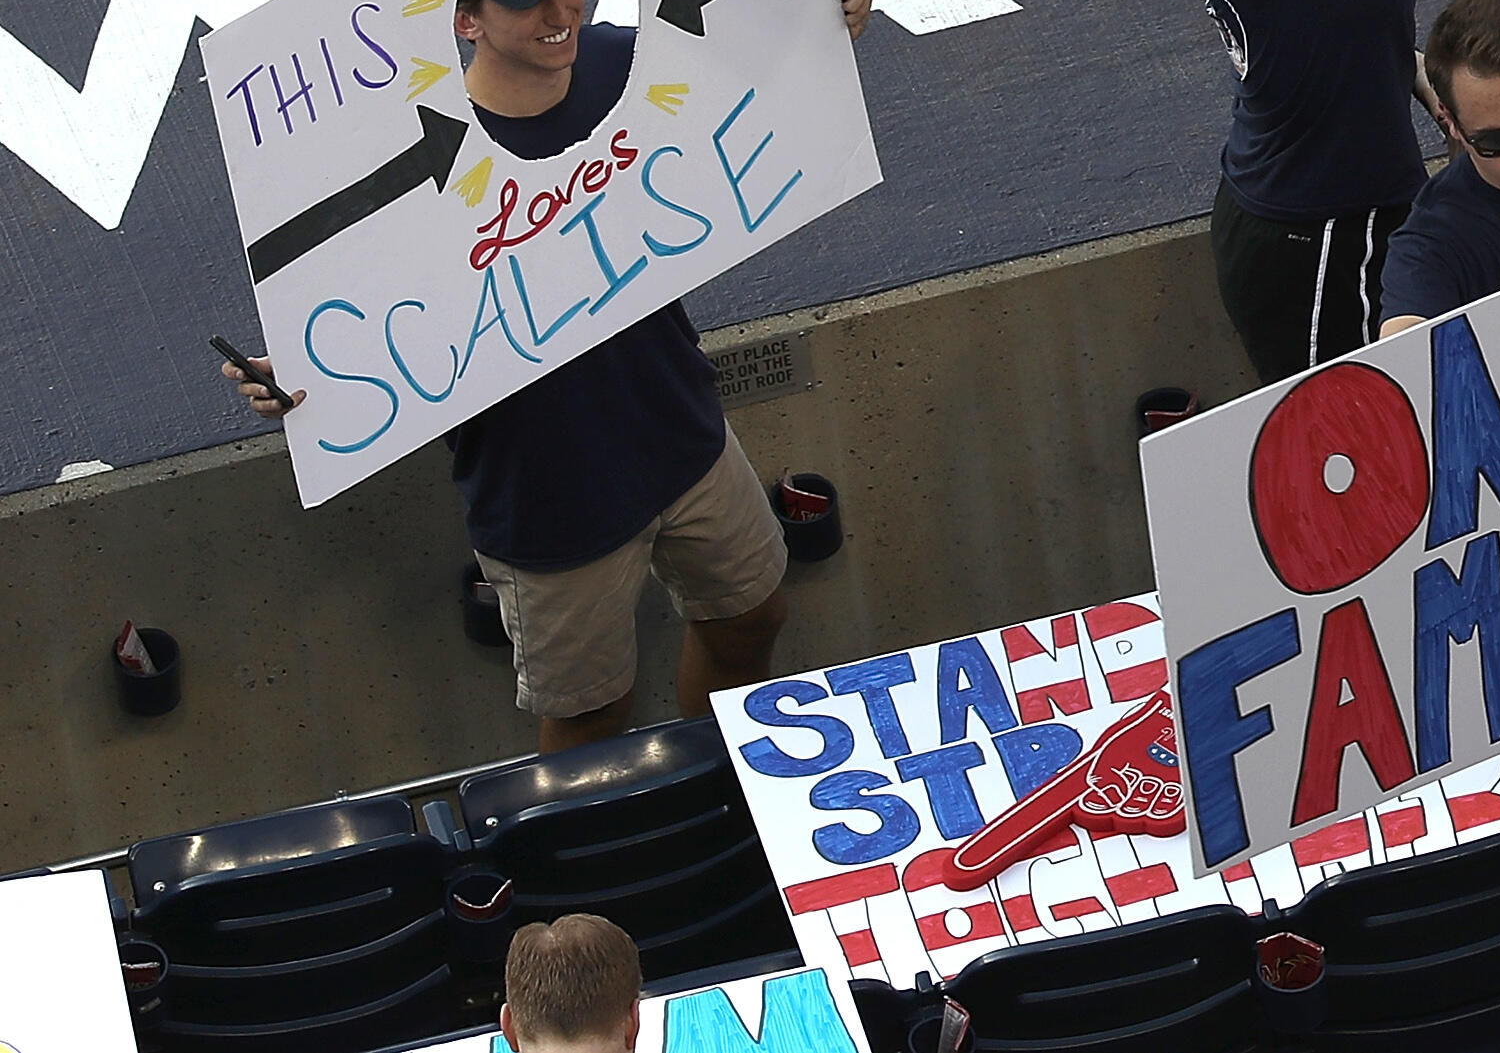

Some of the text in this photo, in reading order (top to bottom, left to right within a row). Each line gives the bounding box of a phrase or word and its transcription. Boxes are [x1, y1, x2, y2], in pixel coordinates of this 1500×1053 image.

[226, 3, 400, 148] THIS
[469, 129, 639, 270] Loves
[303, 87, 803, 454] SCALISE
[710, 339, 791, 368] NOT PLACE
[717, 368, 794, 397] OUT ROOF
[738, 362, 759, 378] ON
[763, 354, 793, 371] THE
[738, 601, 1170, 778] STAND
